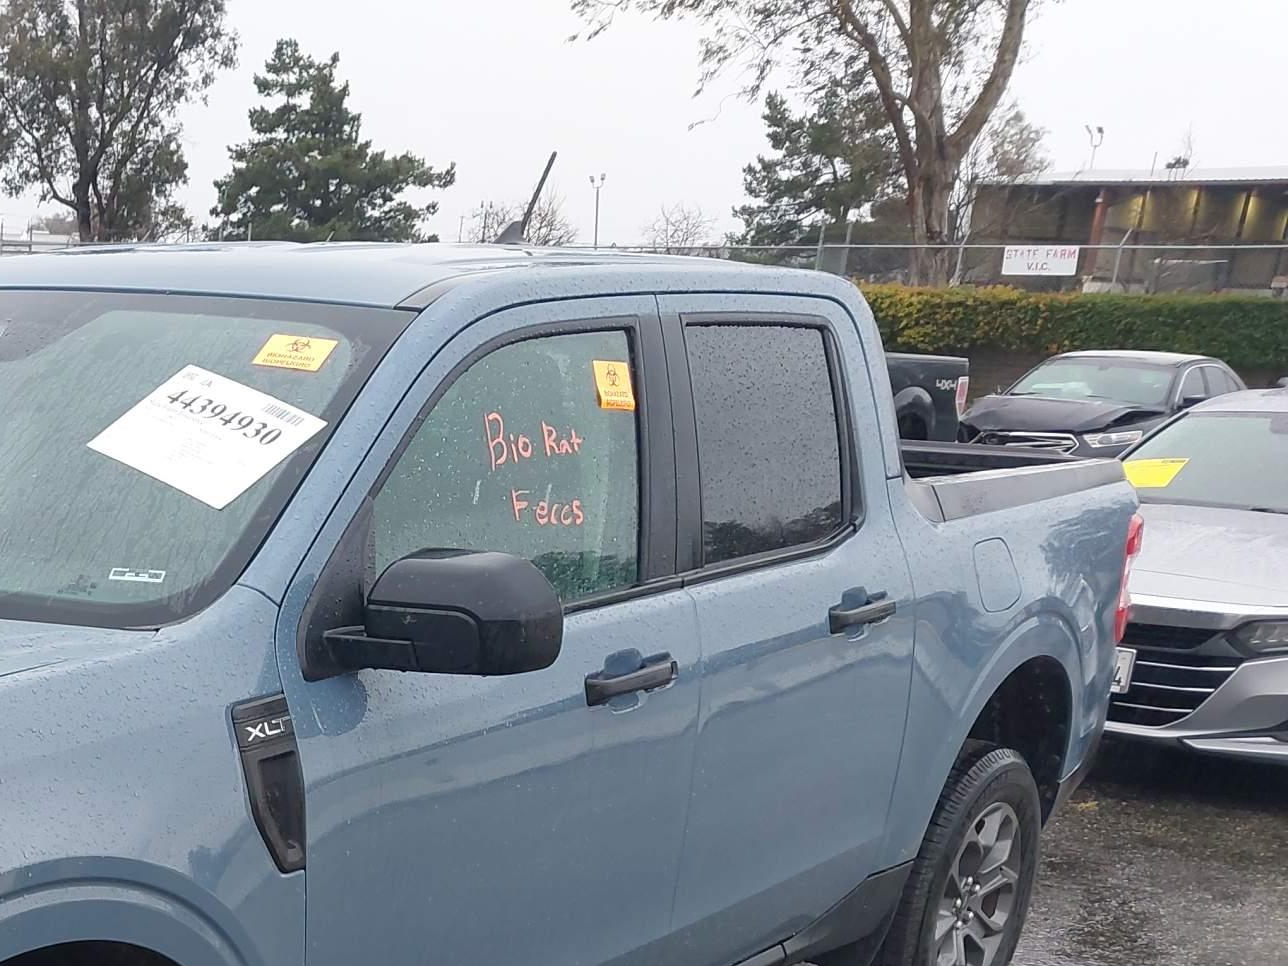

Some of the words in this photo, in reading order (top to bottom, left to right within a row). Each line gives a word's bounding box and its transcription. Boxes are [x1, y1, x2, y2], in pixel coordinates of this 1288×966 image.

[1006, 249, 1040, 260] STATE
[1046, 248, 1077, 260] FARM
[167, 389, 283, 446] 44394930
[483, 412, 532, 471] Bio
[541, 420, 584, 457] Rat
[244, 715, 293, 742] XLT
